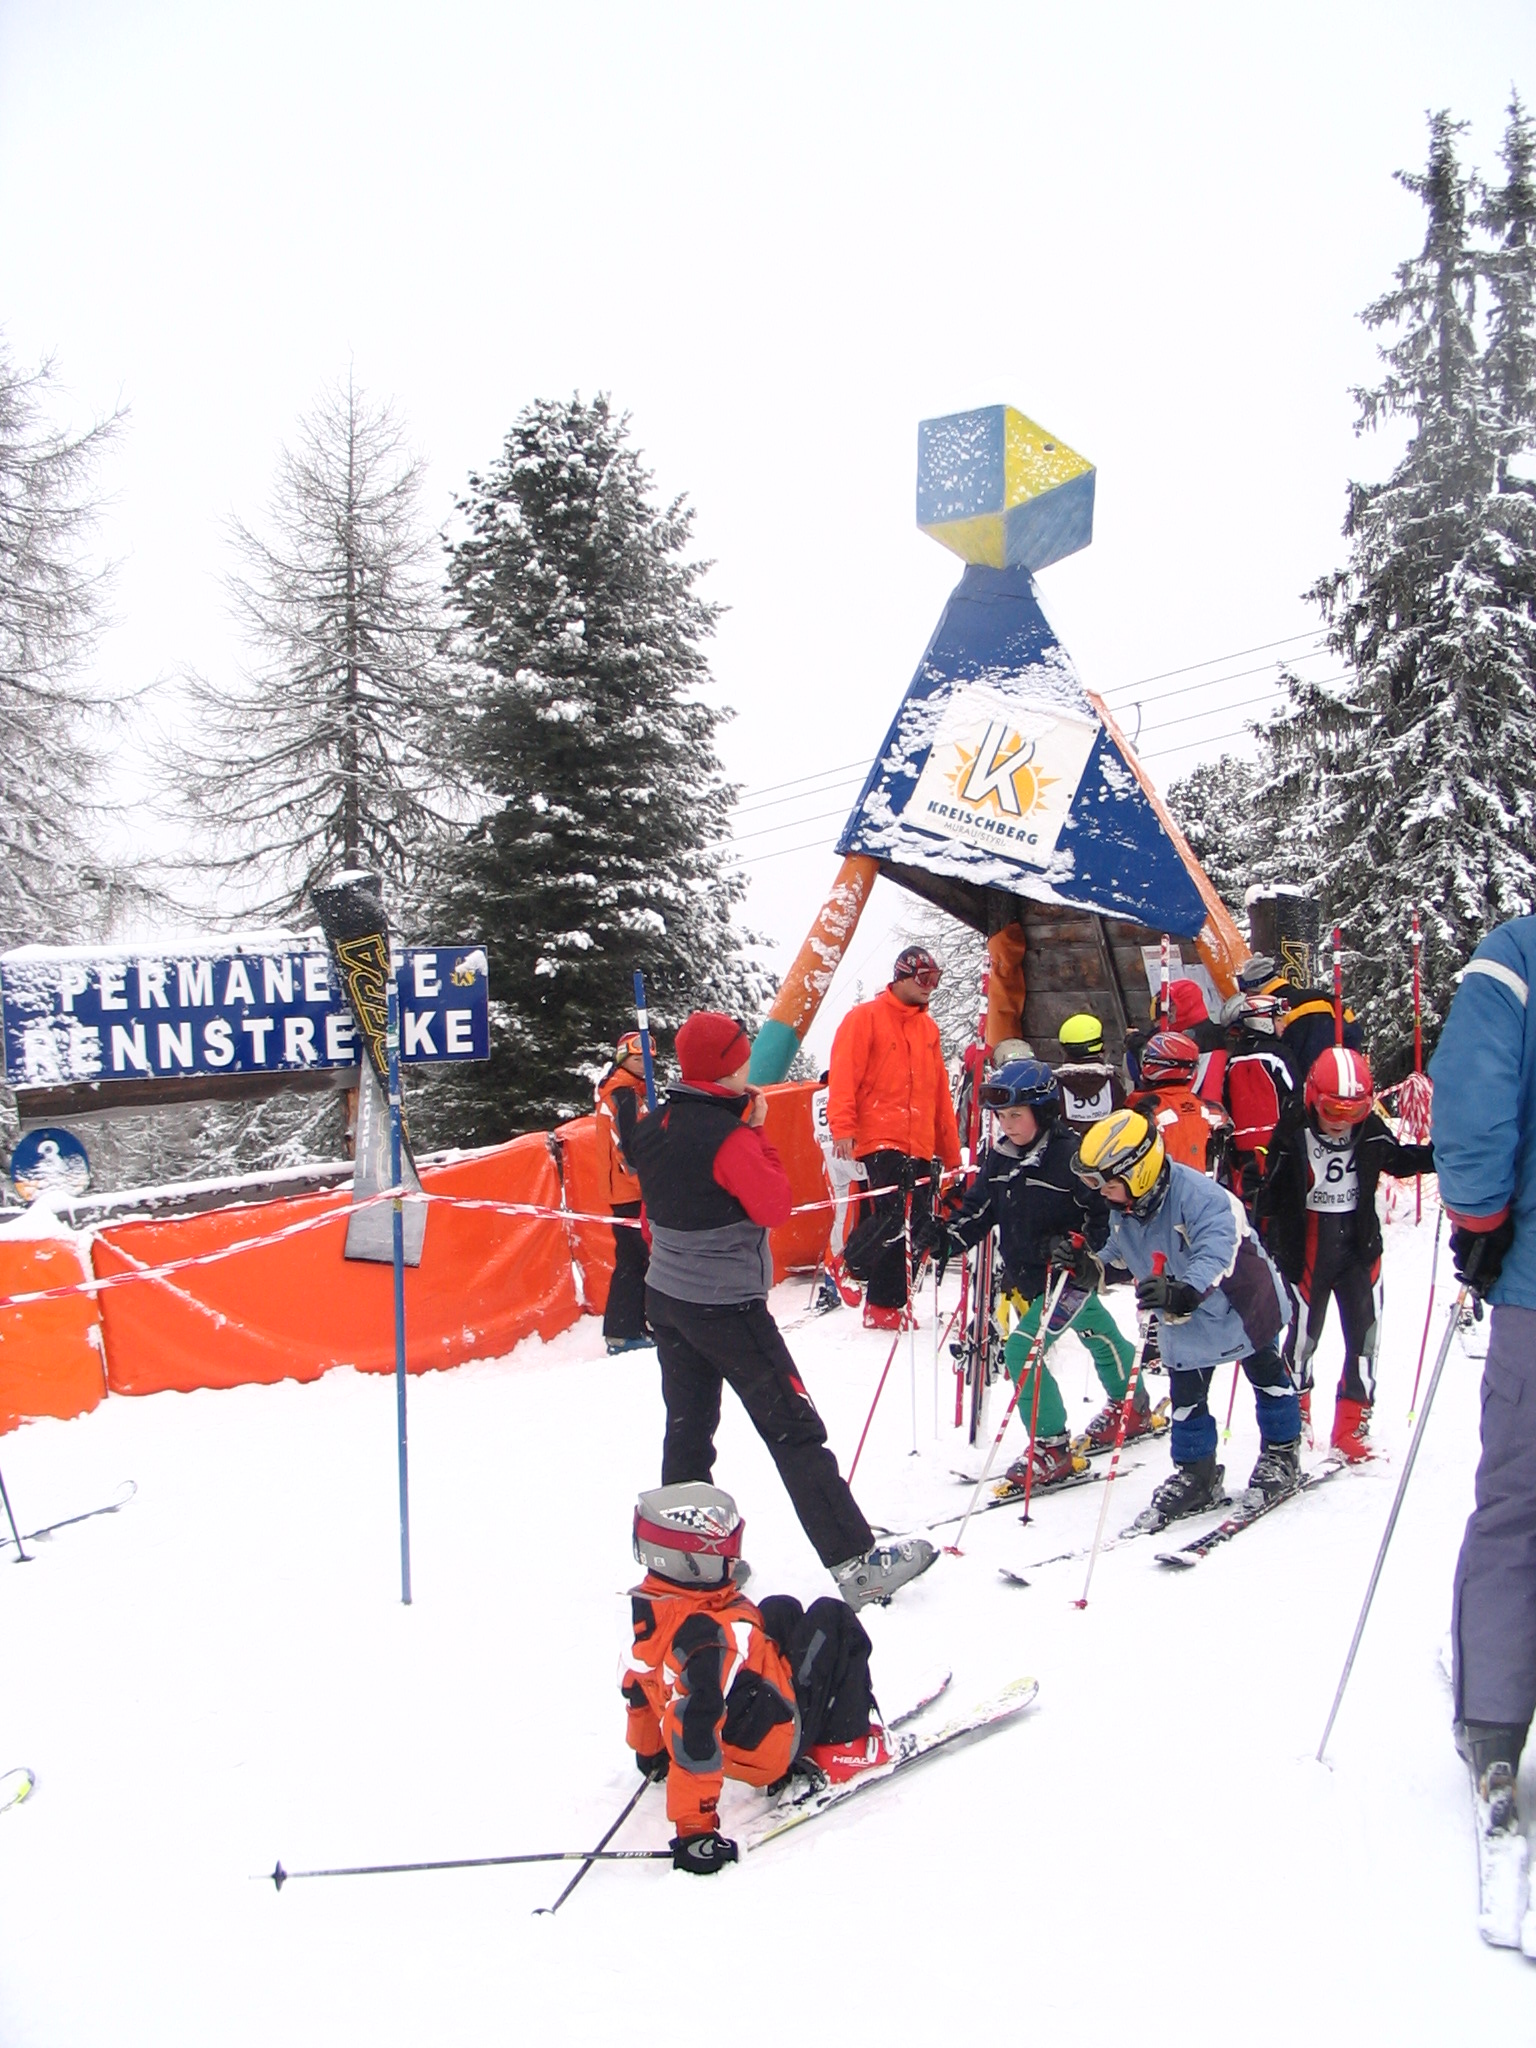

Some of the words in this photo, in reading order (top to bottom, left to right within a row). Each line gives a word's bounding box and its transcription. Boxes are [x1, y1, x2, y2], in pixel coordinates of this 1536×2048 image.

[926, 800, 1040, 846] KREISCHBERG
[61, 953, 439, 1012] PERMANEE
[24, 1010, 473, 1078] RENNSTREKE
